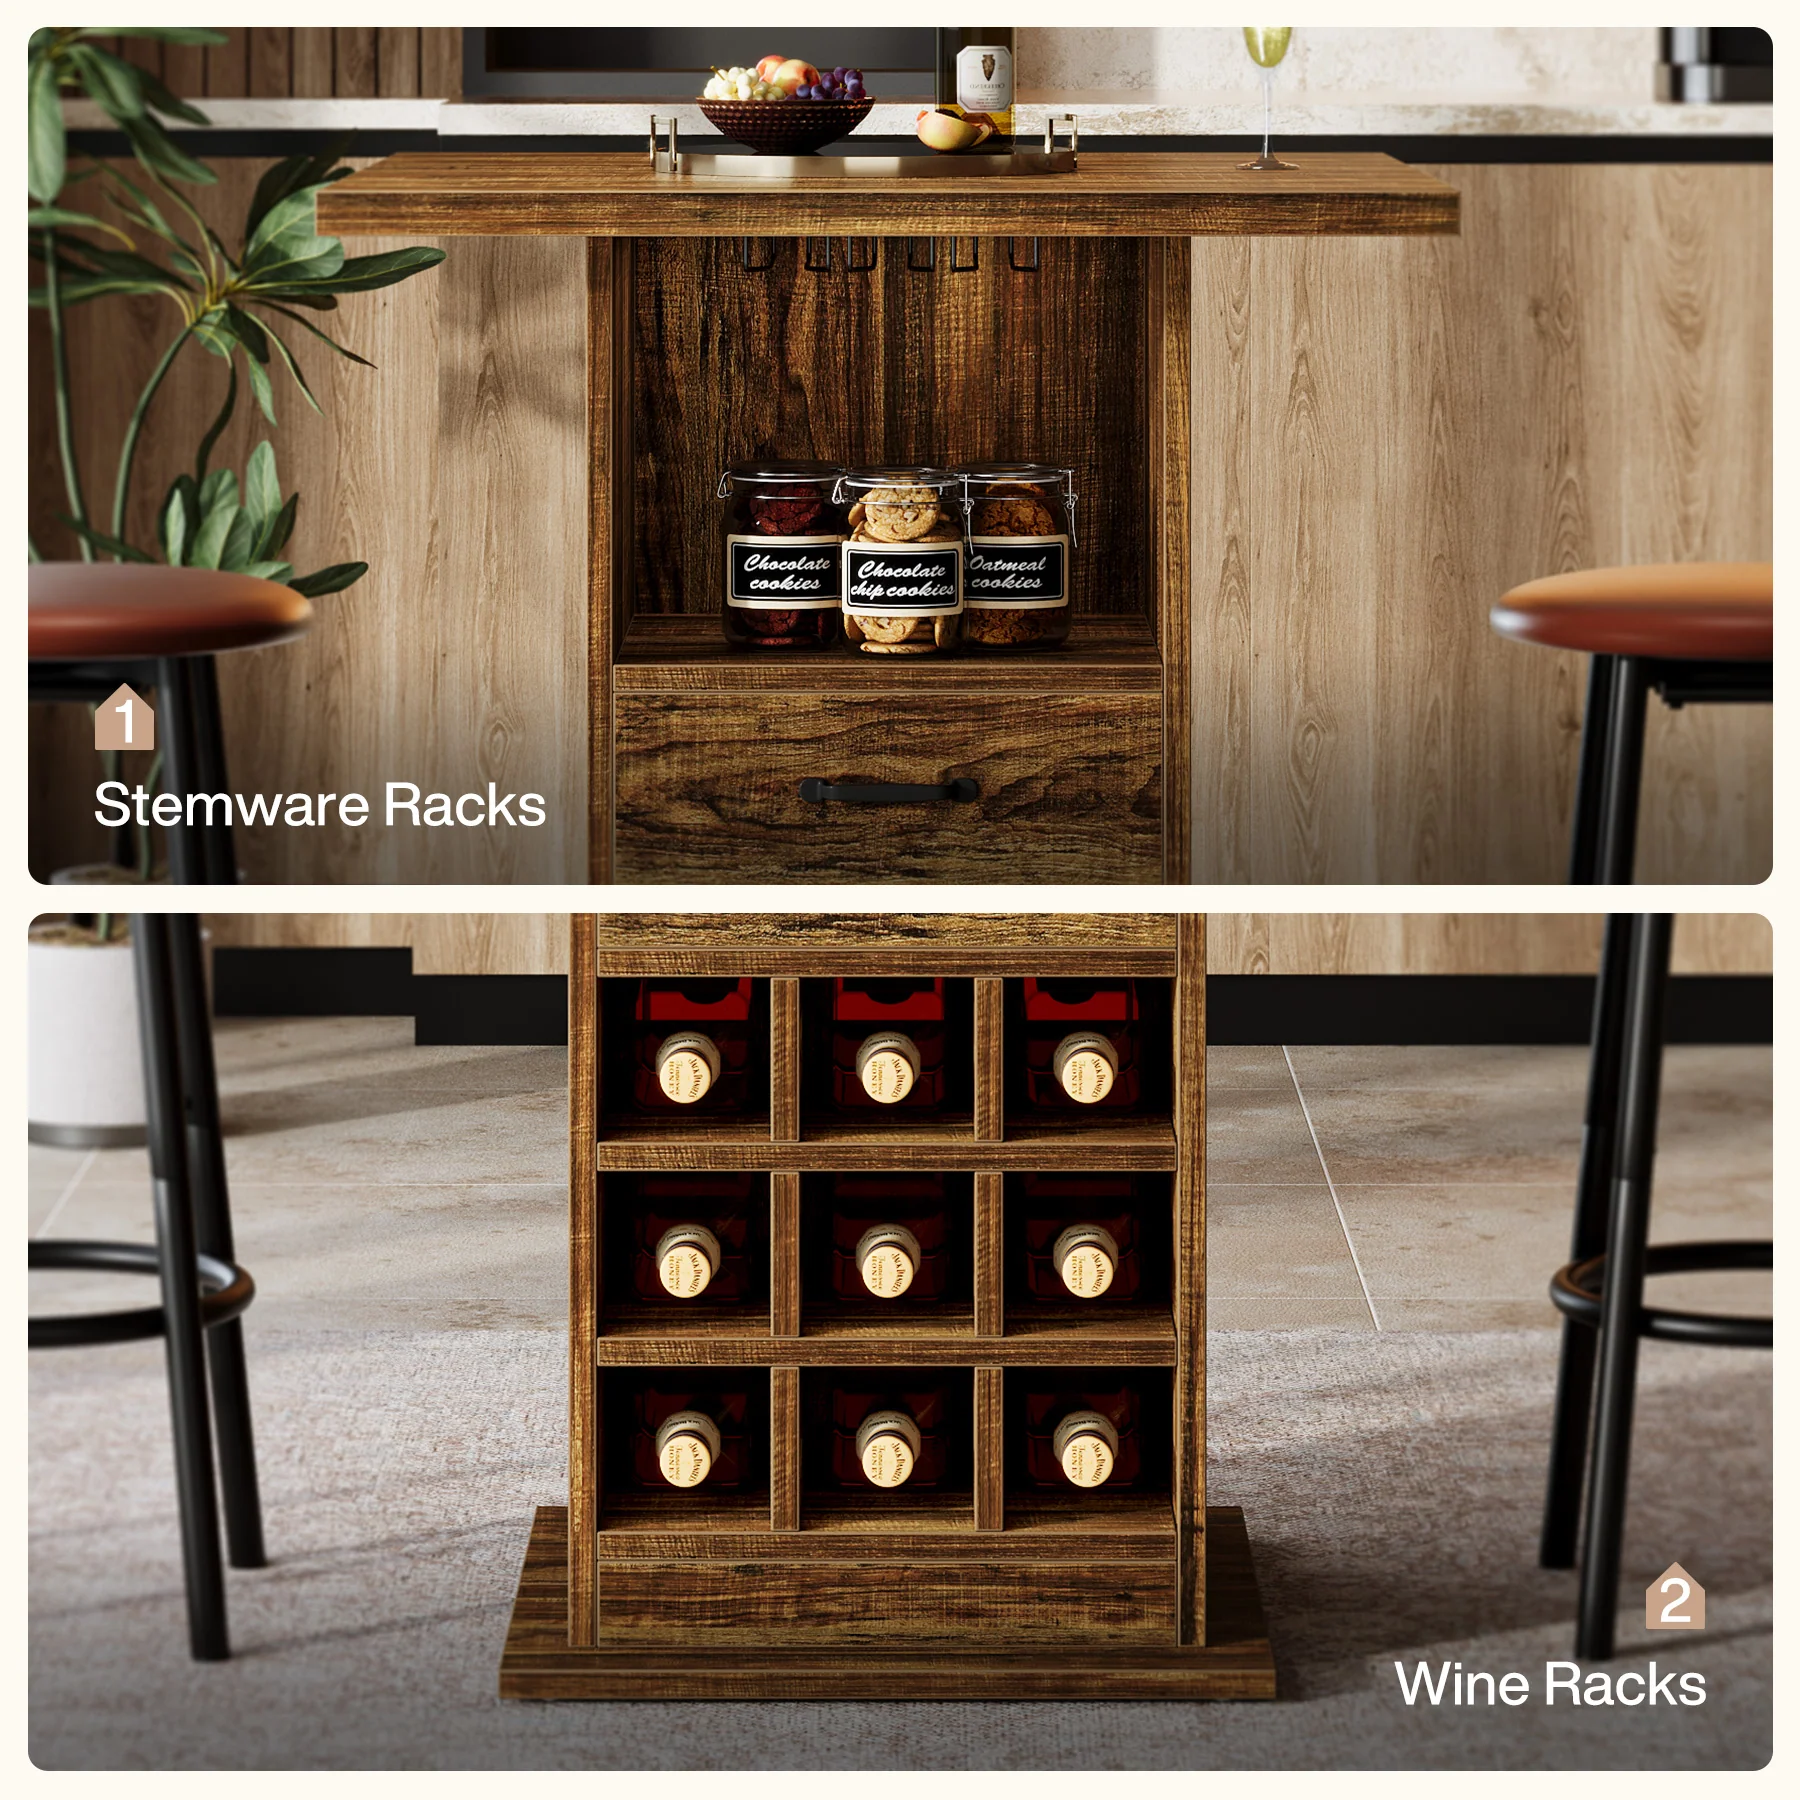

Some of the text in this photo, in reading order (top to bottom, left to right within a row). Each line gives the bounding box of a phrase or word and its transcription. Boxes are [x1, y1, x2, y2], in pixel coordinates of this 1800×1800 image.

[743, 553, 831, 572] Chocolate
[857, 560, 946, 579] Chocolate
[969, 554, 1047, 571] Oatmeal
[749, 574, 821, 590] cookies
[971, 572, 1043, 589] cookies
[850, 580, 956, 600] chip cookies
